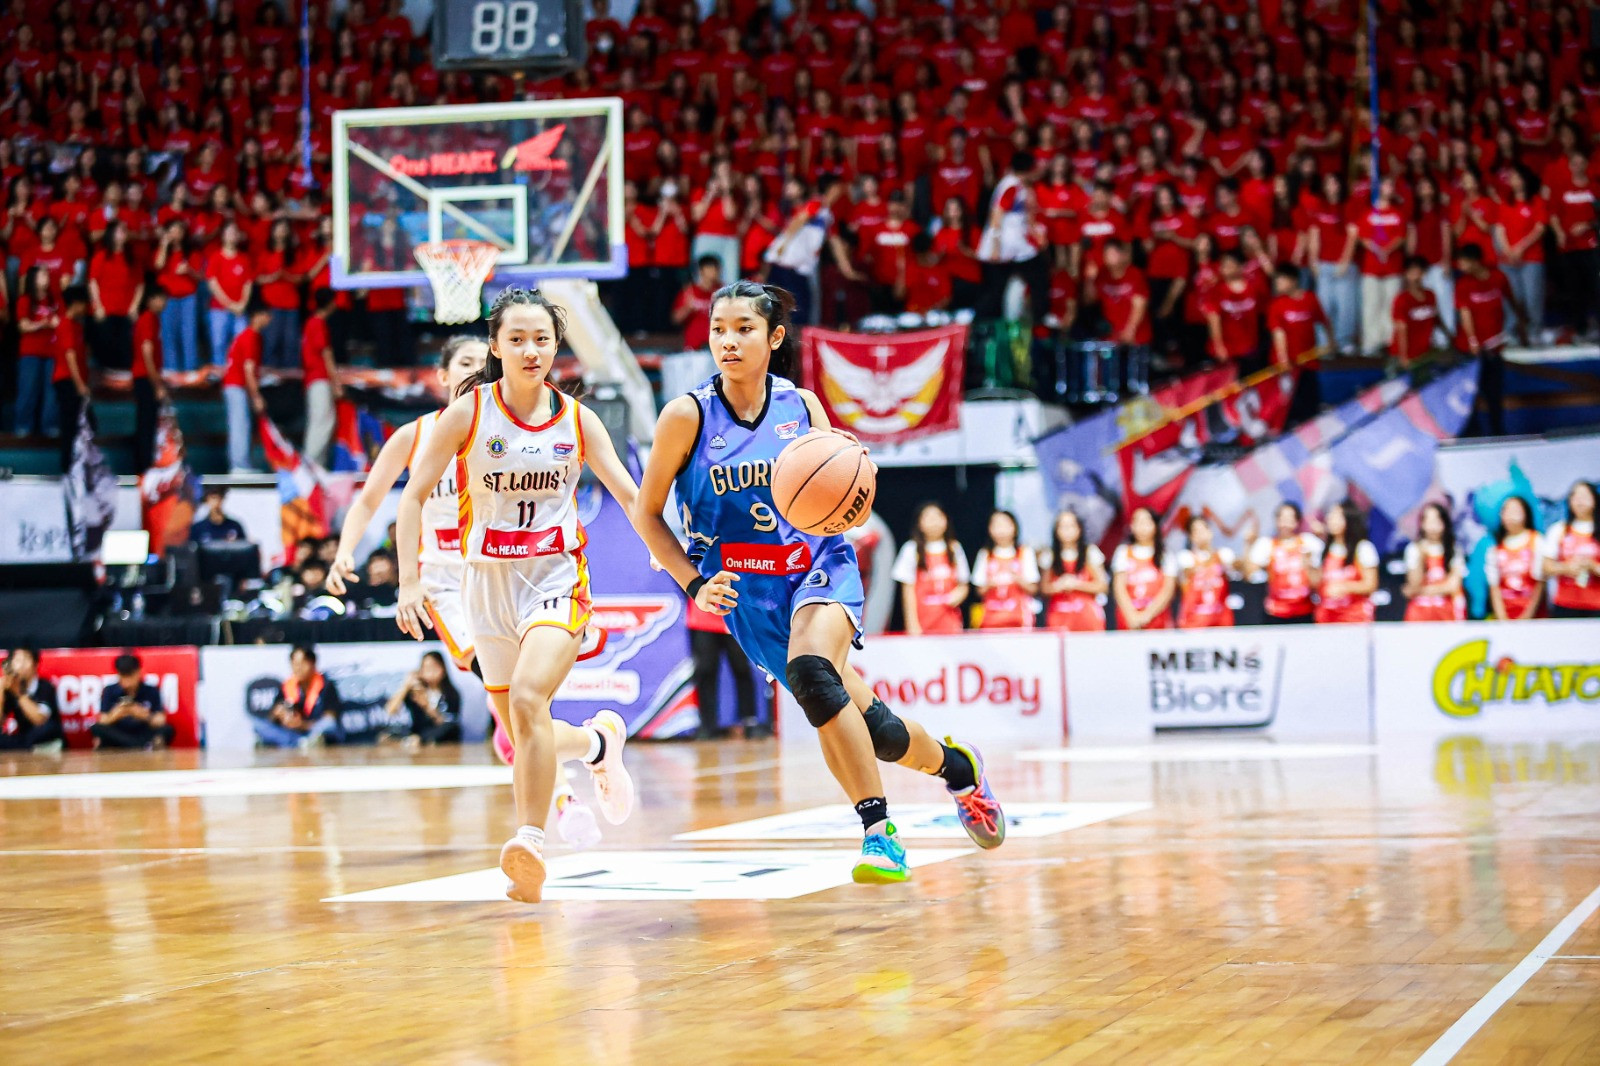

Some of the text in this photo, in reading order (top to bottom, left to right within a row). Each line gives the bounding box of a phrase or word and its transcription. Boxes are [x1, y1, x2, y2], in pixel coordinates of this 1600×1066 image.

[709, 457, 777, 496] GLOR
[517, 500, 535, 528] 11
[750, 501, 778, 533] 9
[842, 486, 870, 525] DBL
[486, 542, 498, 555] One
[725, 557, 776, 571] One HEART.
[851, 663, 1041, 716] ood Day
